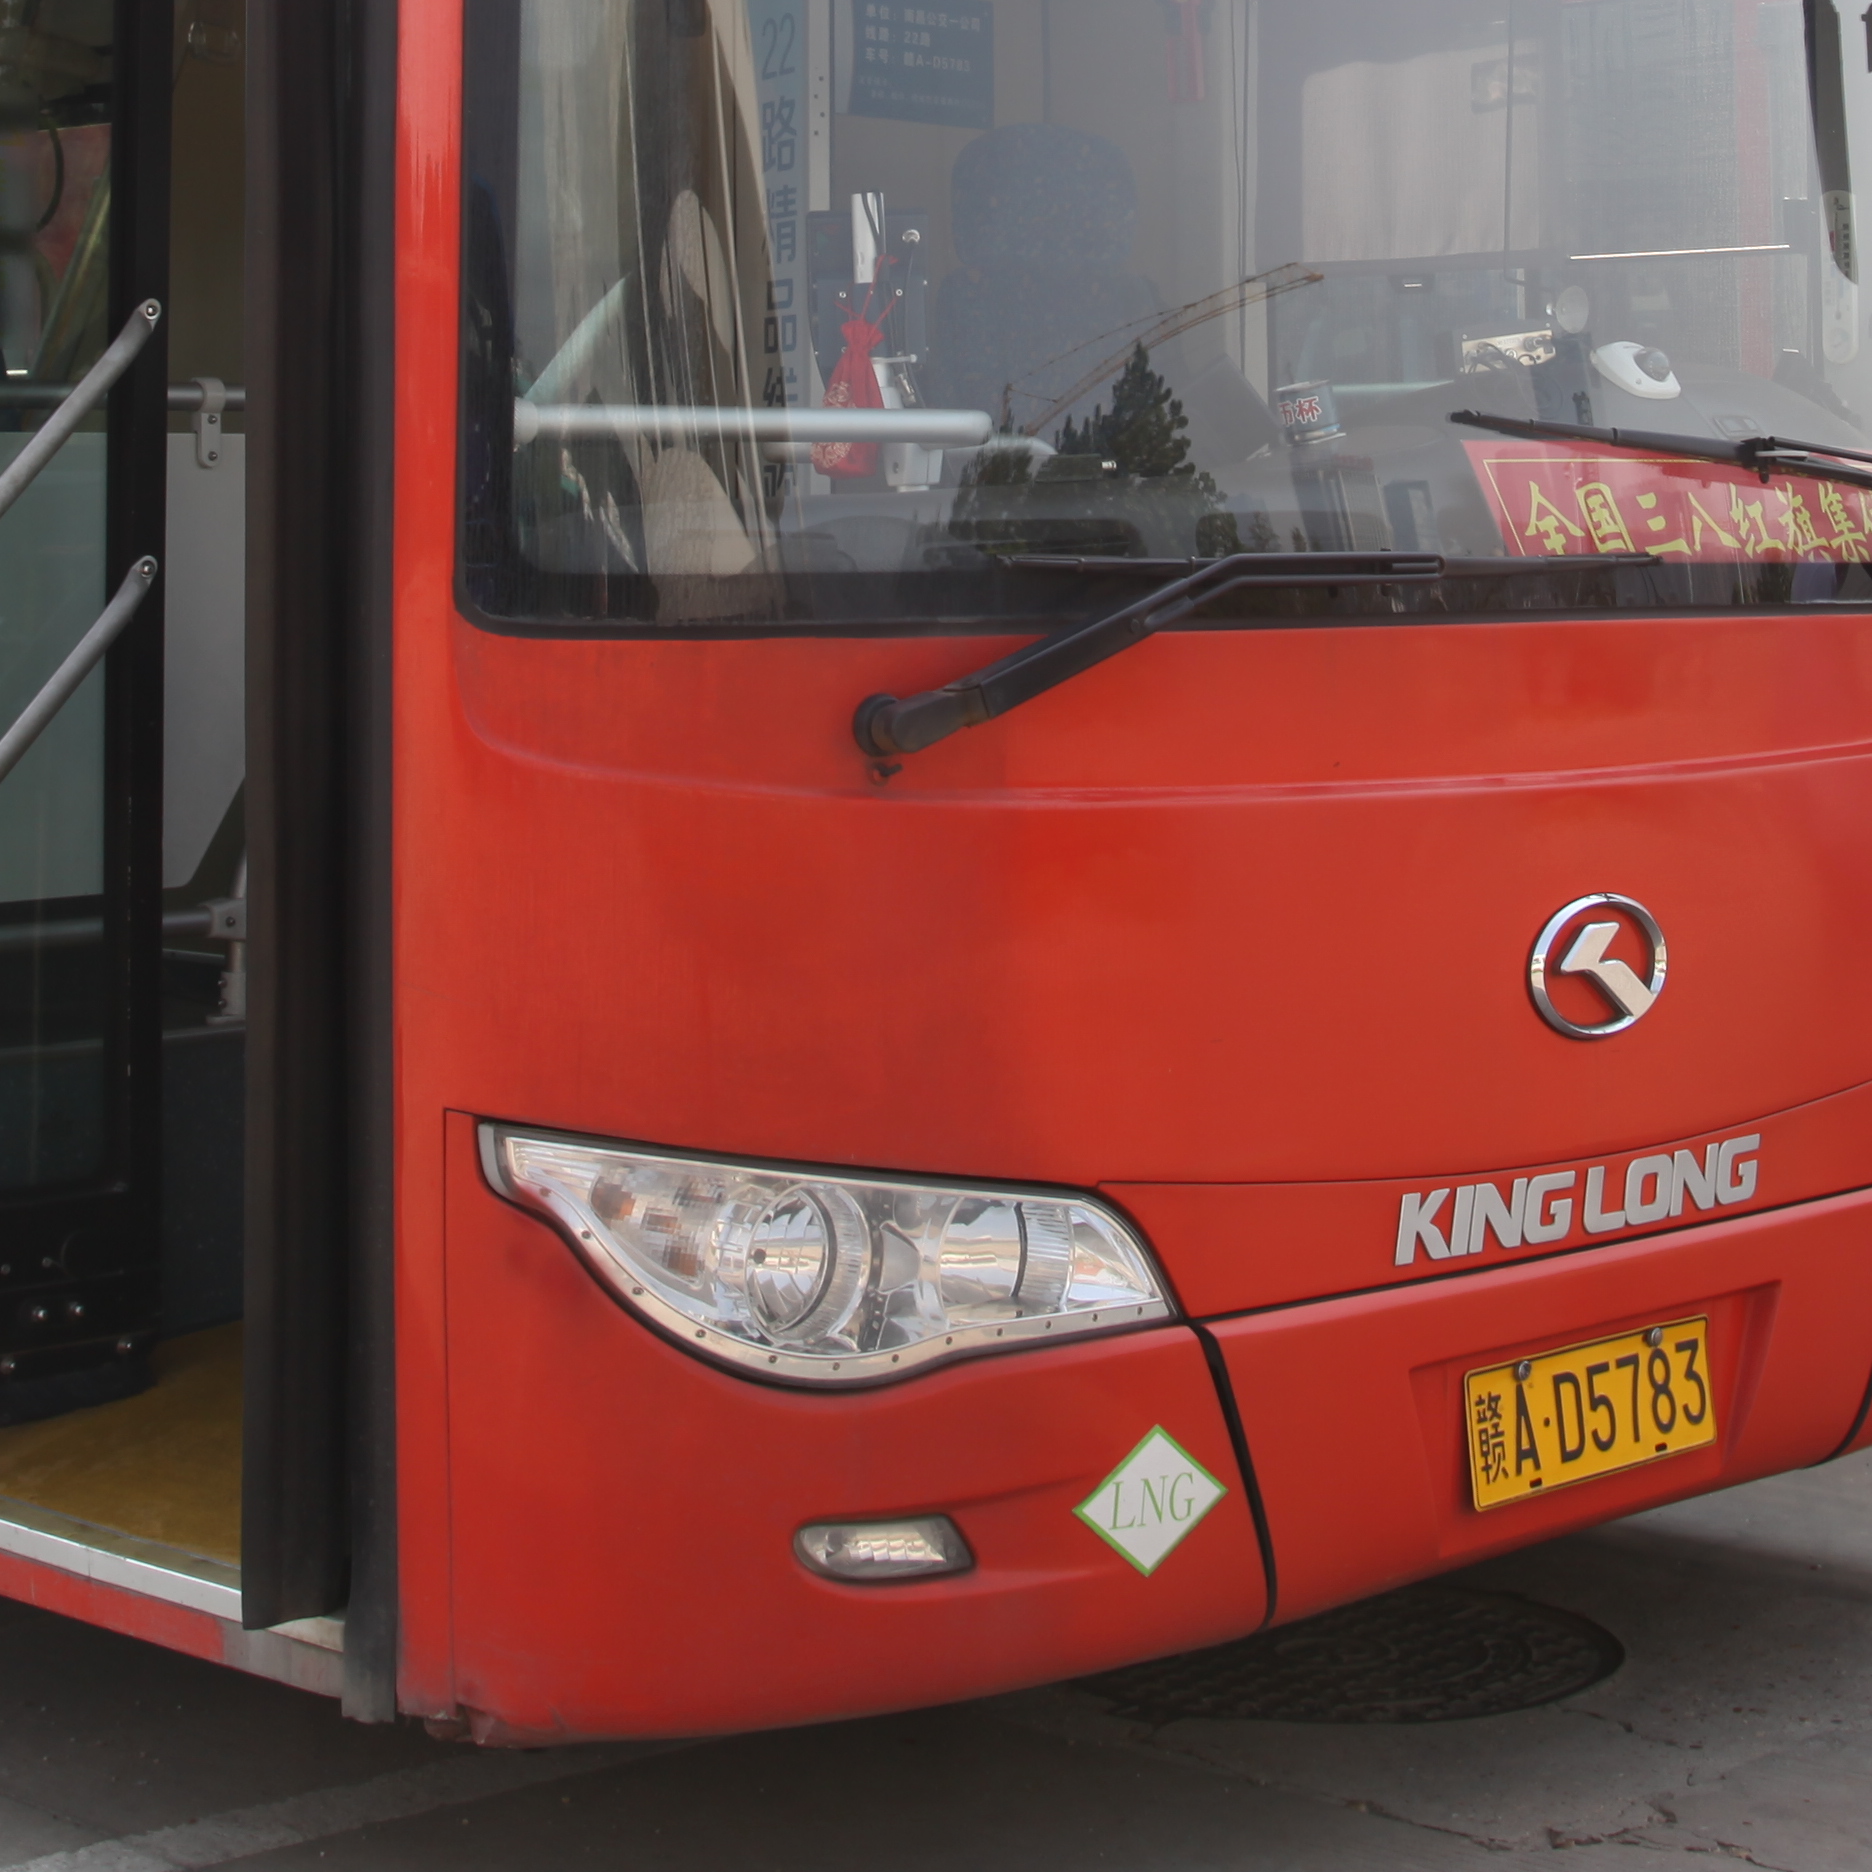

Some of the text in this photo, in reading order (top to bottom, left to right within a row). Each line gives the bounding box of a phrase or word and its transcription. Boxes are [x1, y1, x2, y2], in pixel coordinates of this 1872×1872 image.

[1394, 1132, 1762, 1266] KING LONG
[1108, 1466, 1197, 1532] LNG
